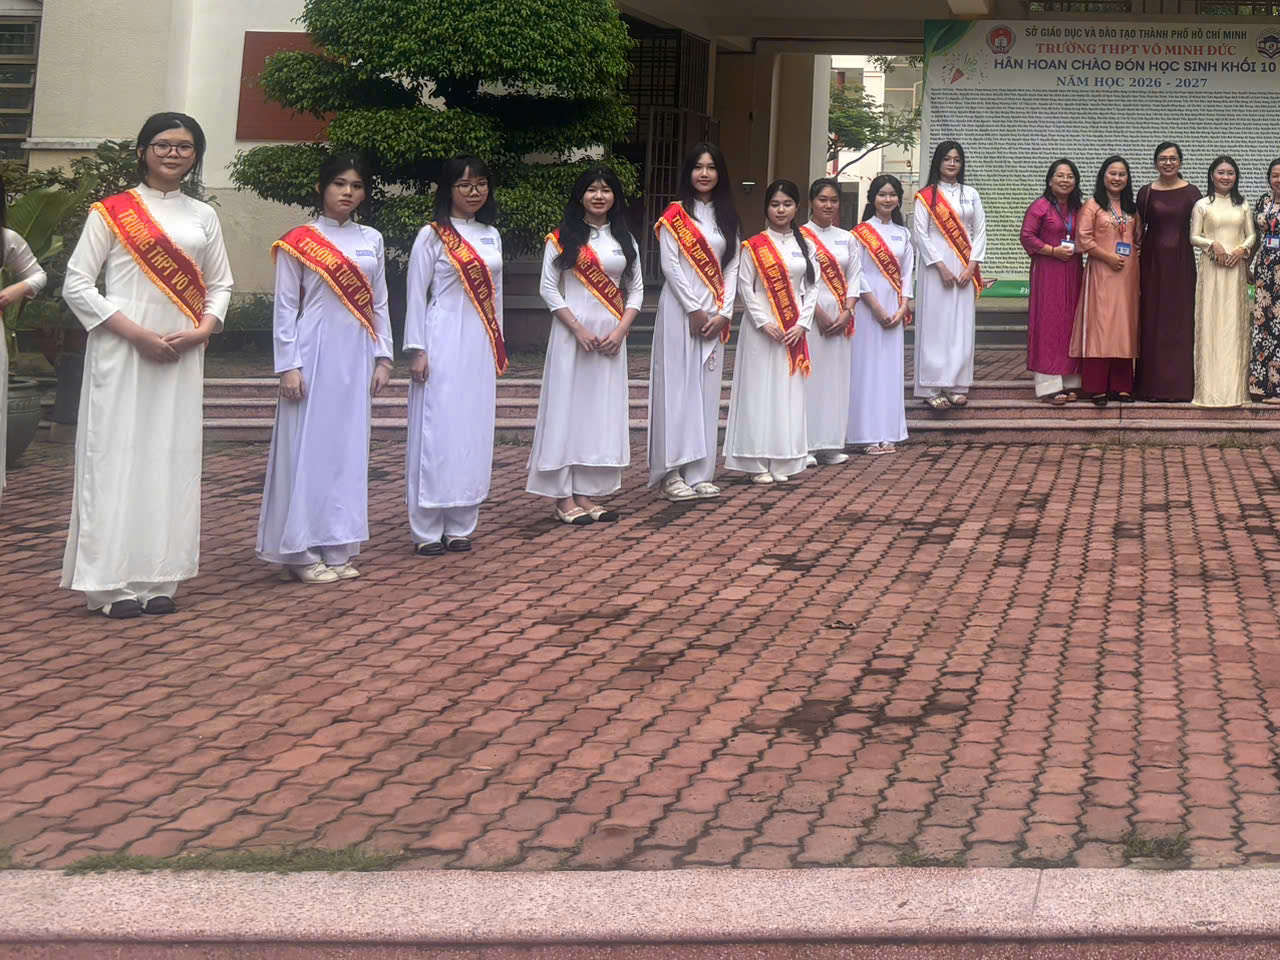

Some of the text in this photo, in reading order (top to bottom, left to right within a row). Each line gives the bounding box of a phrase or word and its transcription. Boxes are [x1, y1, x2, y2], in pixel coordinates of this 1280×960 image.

[1025, 27, 1247, 40] SỞ GIÁO DỤC VÀ ĐÀO TẠO THÀNH PHỐ HỒ CHÍ MINH
[1036, 40, 1237, 56] TRƯỜNG THPT VÕ MINH ĐỨC
[994, 56, 1276, 74] HÂN HOAN CHÀO ĐÓN HỌC SINH KHỐI 10
[1056, 74, 1088, 87] NĂM
[1095, 77, 1125, 90] HỌC
[1128, 78, 1161, 88] 2026
[1175, 78, 1208, 88] 2027
[118, 208, 156, 251] TRƯỜNG
[148, 246, 178, 276] THPT
[171, 270, 192, 290] VÕ
[672, 214, 716, 276] TRƯỜNG THPT VÕ
[299, 237, 342, 271] TRƯỜNG
[336, 264, 361, 292] THPT
[876, 248, 890, 265] THPT
[467, 260, 484, 285] THPT
[586, 265, 608, 287] THPT
[767, 265, 782, 281] THPT
